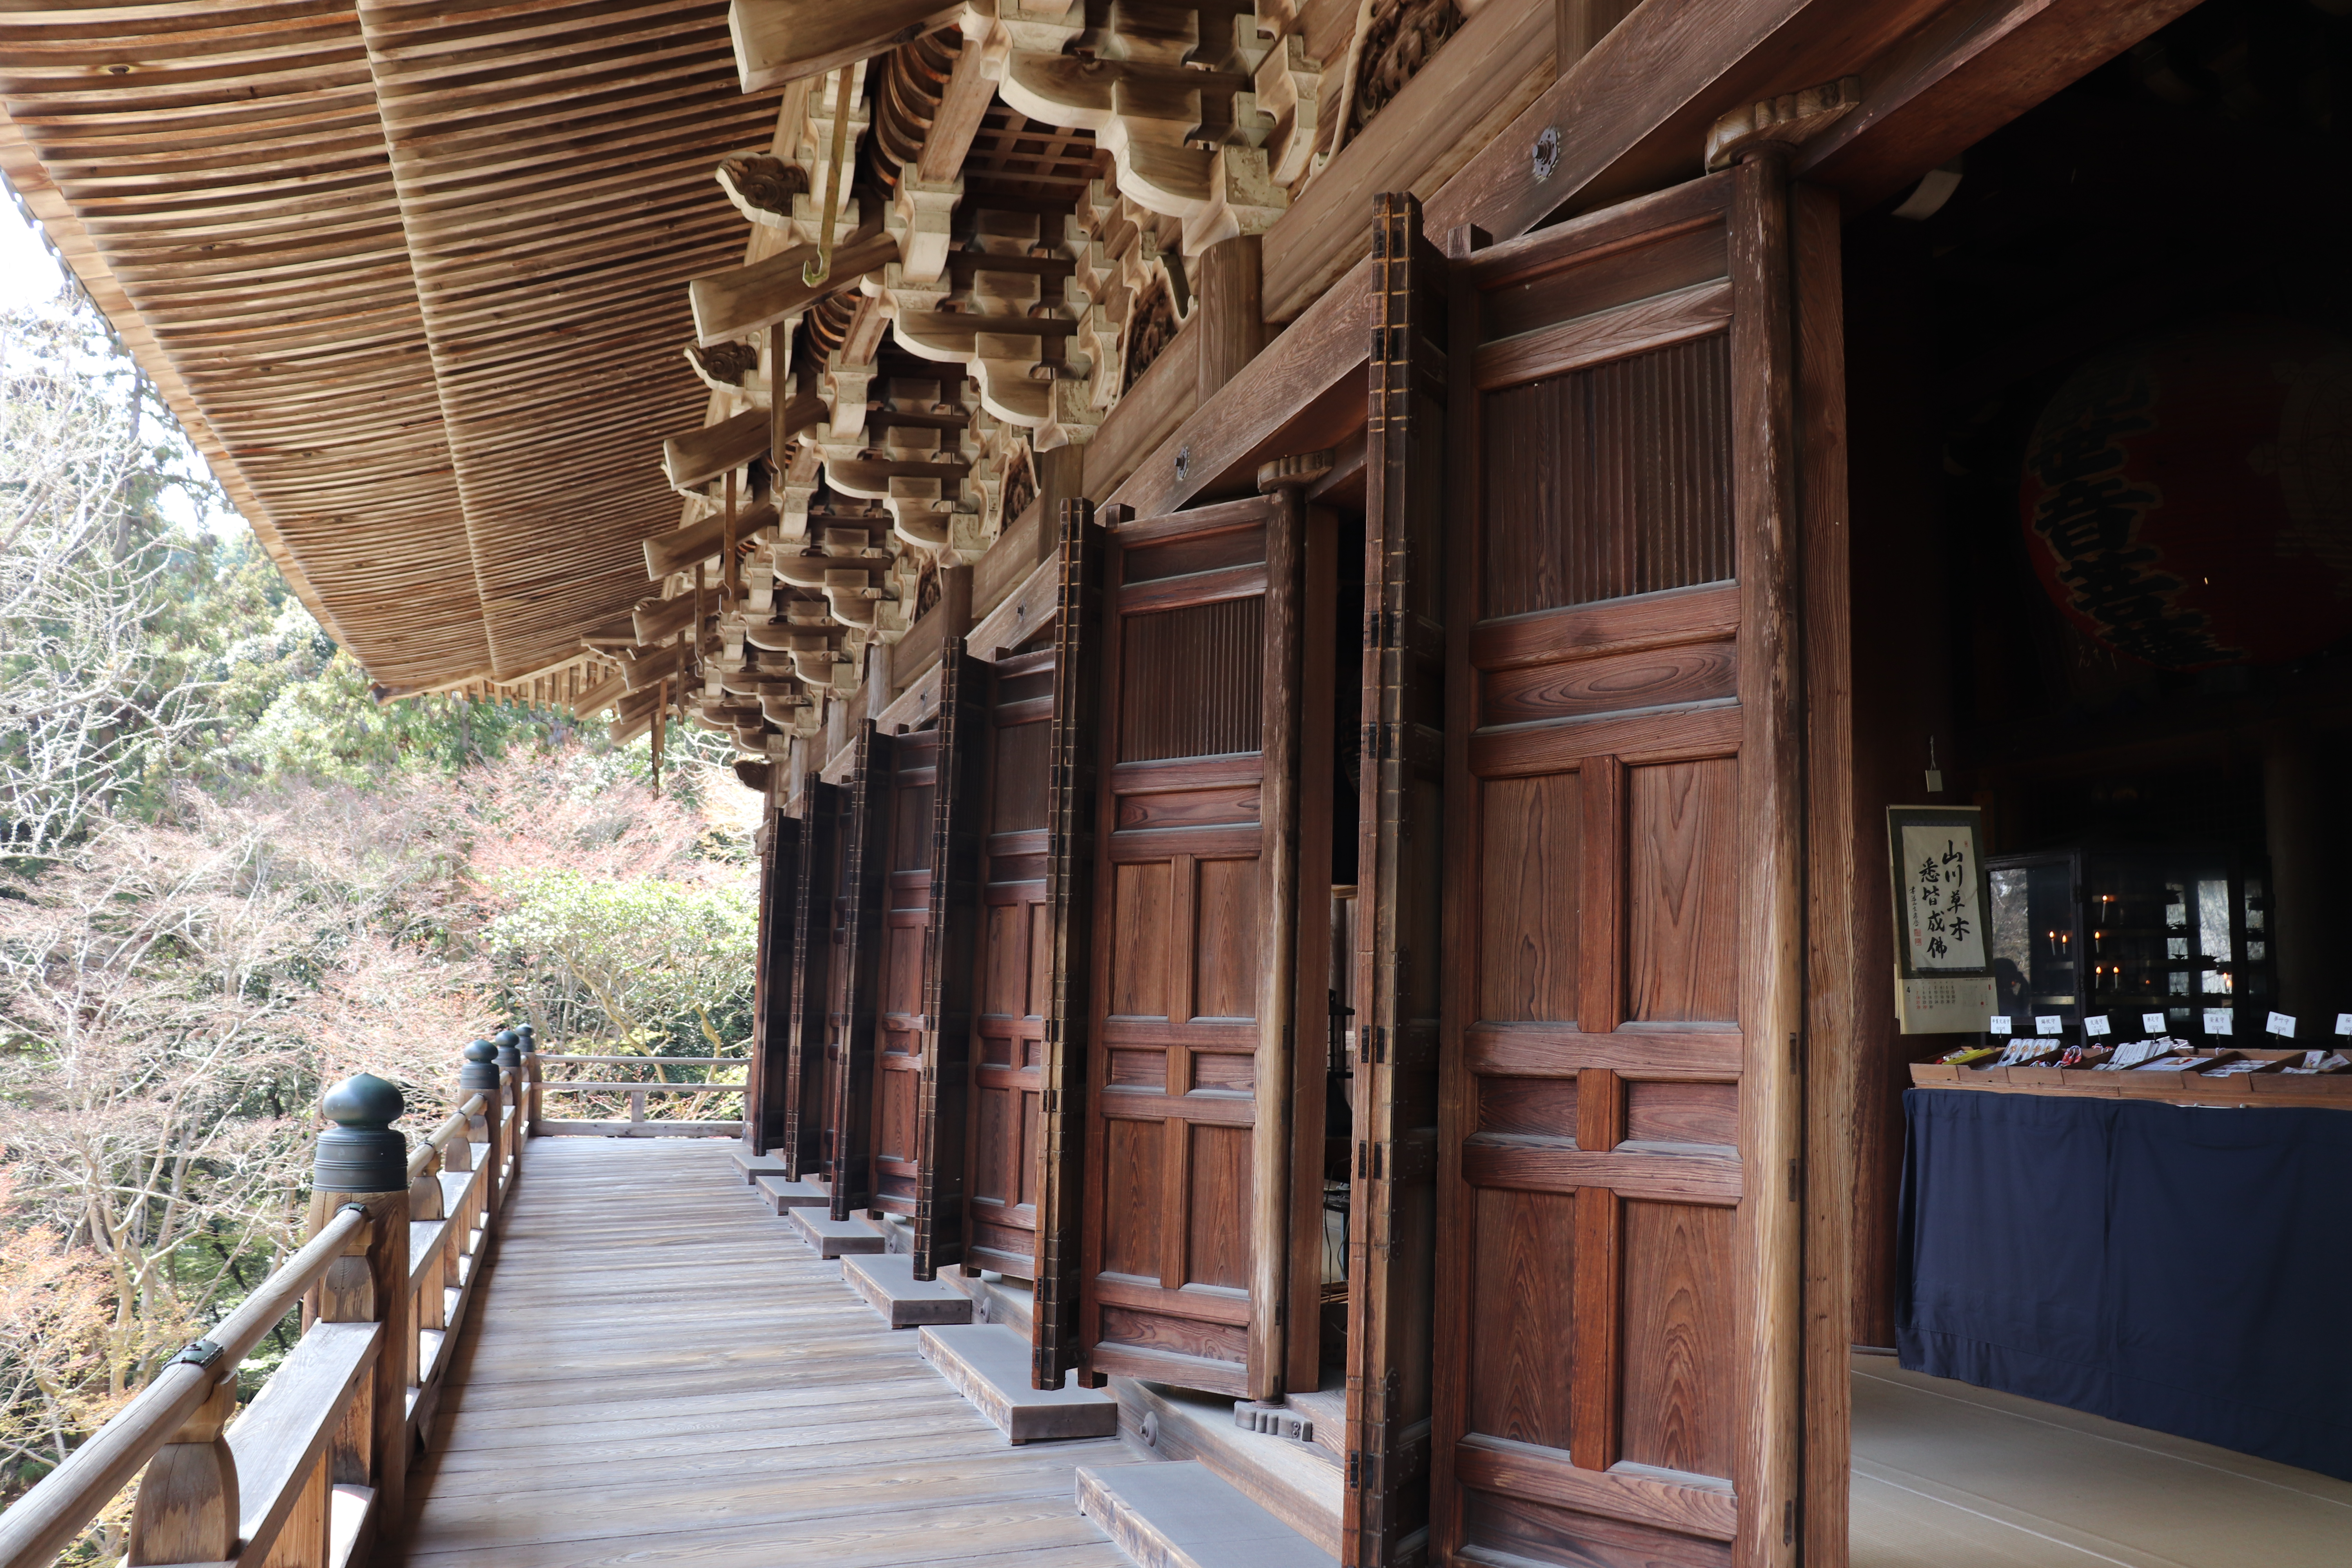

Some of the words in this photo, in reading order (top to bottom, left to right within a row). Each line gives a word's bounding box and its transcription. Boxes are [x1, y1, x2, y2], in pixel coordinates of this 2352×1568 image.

[1918, 857, 1948, 959] 悉皆成佛
[1942, 840, 1970, 942] 山川草木
